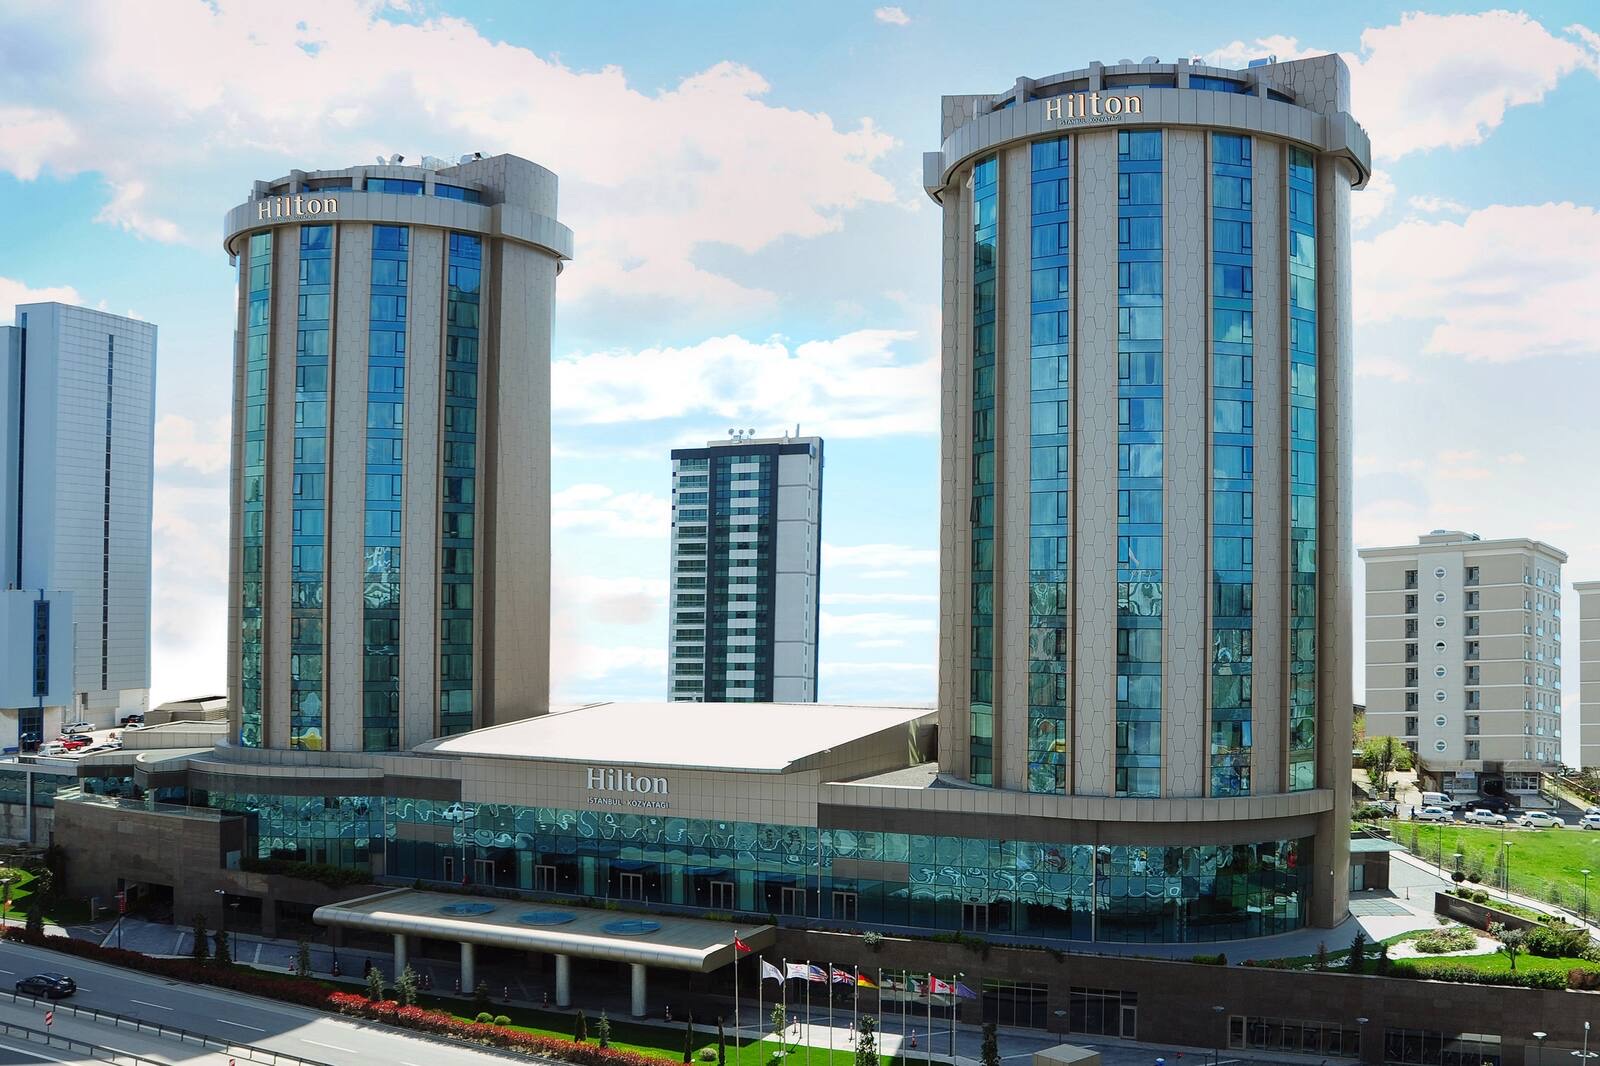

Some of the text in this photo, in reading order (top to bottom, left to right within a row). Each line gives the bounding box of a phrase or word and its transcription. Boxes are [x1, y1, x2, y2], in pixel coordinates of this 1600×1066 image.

[1046, 92, 1143, 121] Hilton
[258, 194, 338, 220] Hilton
[587, 767, 669, 794] Hilton
